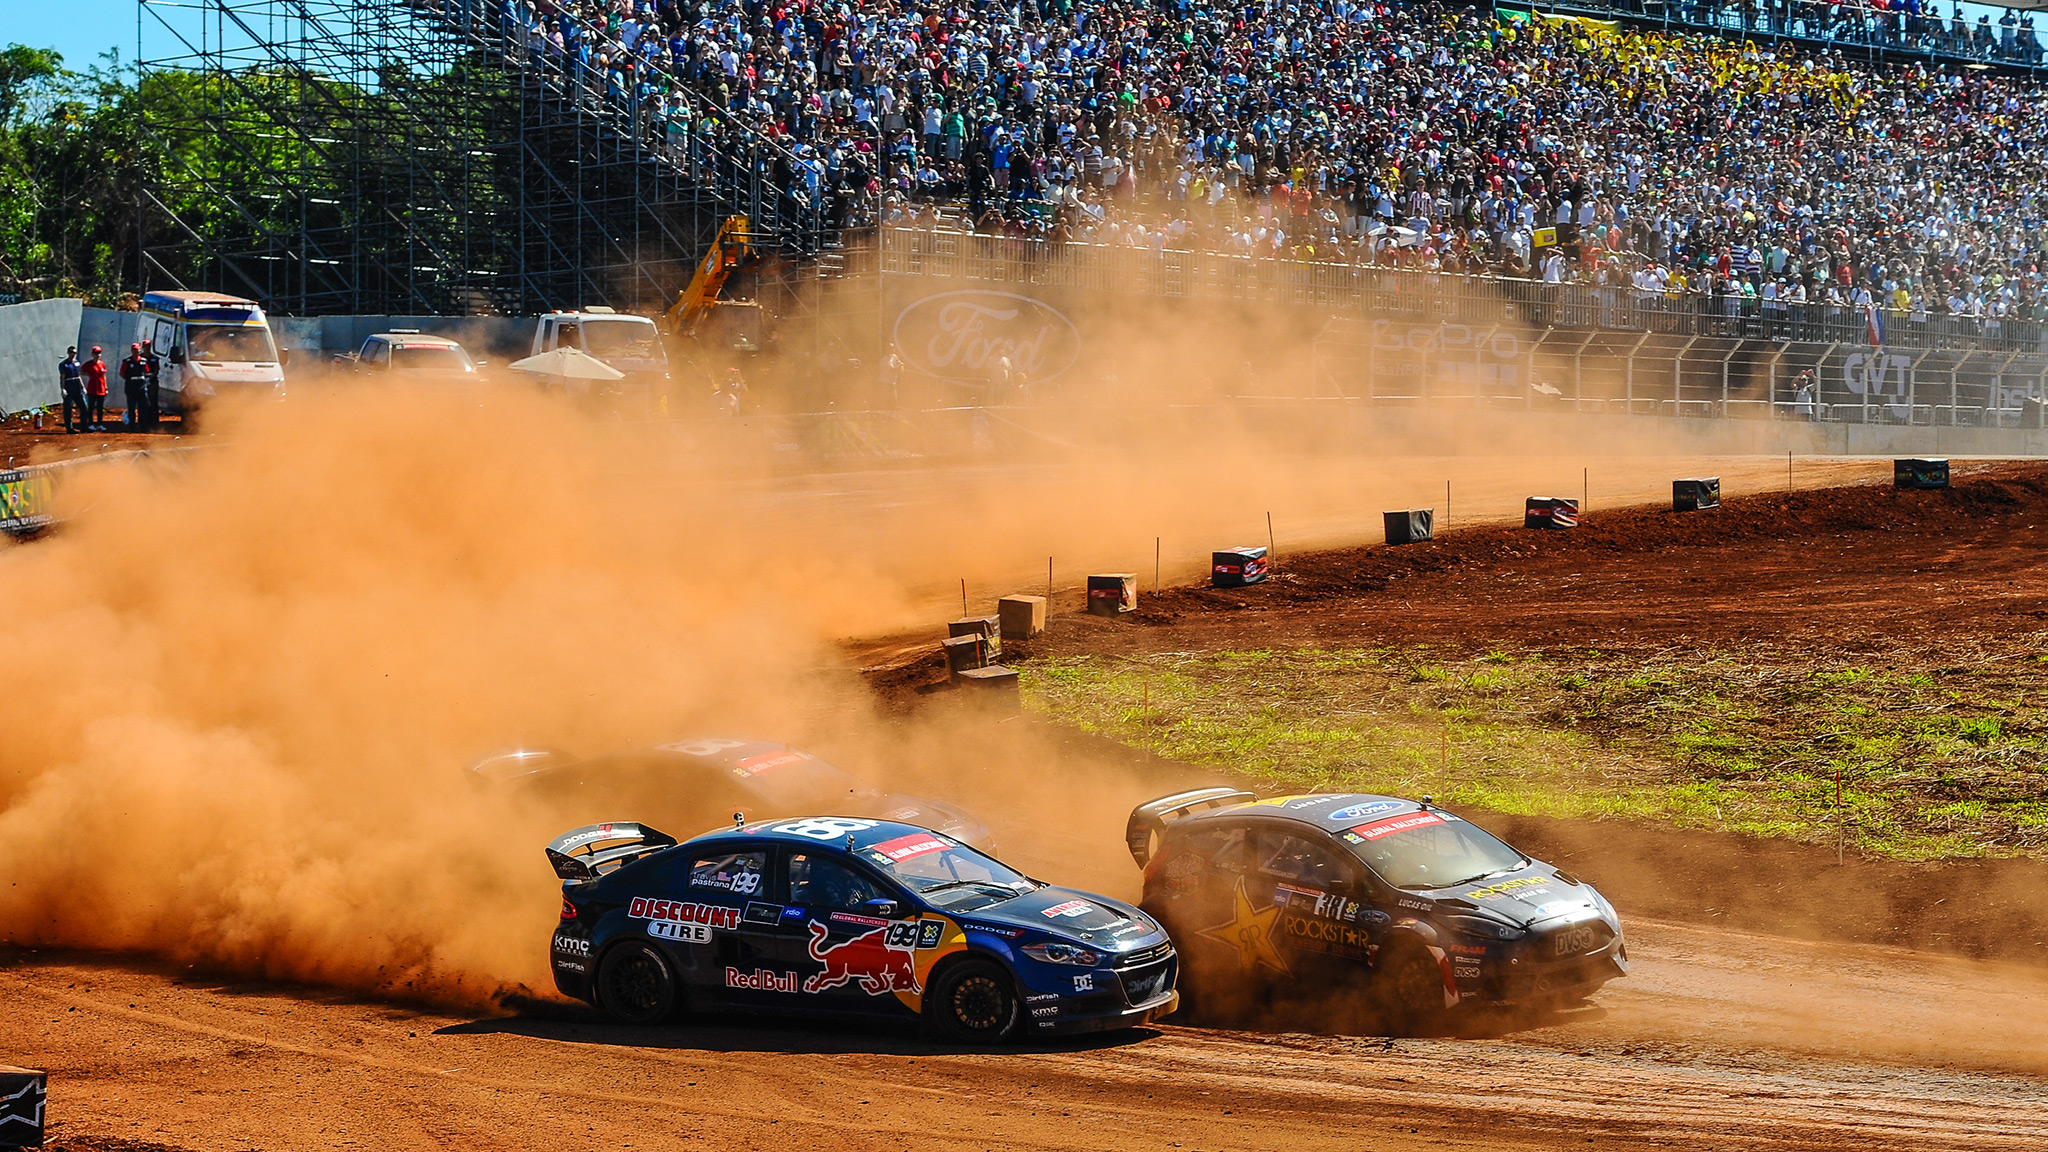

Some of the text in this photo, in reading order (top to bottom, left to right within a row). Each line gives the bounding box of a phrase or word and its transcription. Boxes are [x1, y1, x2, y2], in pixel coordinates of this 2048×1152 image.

[928, 302, 1048, 374] Ford
[1373, 319, 1519, 359] GoPro
[1844, 352, 1911, 396] GVT
[1291, 797, 1329, 809] LUCAS
[1345, 803, 1392, 817] Ford
[1363, 825, 1396, 838] GLOBAL
[694, 871, 717, 880] travis
[730, 872, 760, 894] 199
[691, 878, 730, 889] pastrana
[1398, 898, 1432, 912] LUCAS OIL
[629, 897, 741, 929] DISCOUNT
[656, 922, 705, 941] TIRE
[885, 923, 919, 947] 199
[964, 923, 1018, 938] DODGE
[555, 935, 590, 951] kmc
[1451, 943, 1487, 955] FRAM
[726, 967, 798, 993] Red Bull
[1026, 992, 1059, 1002] DirtFish
